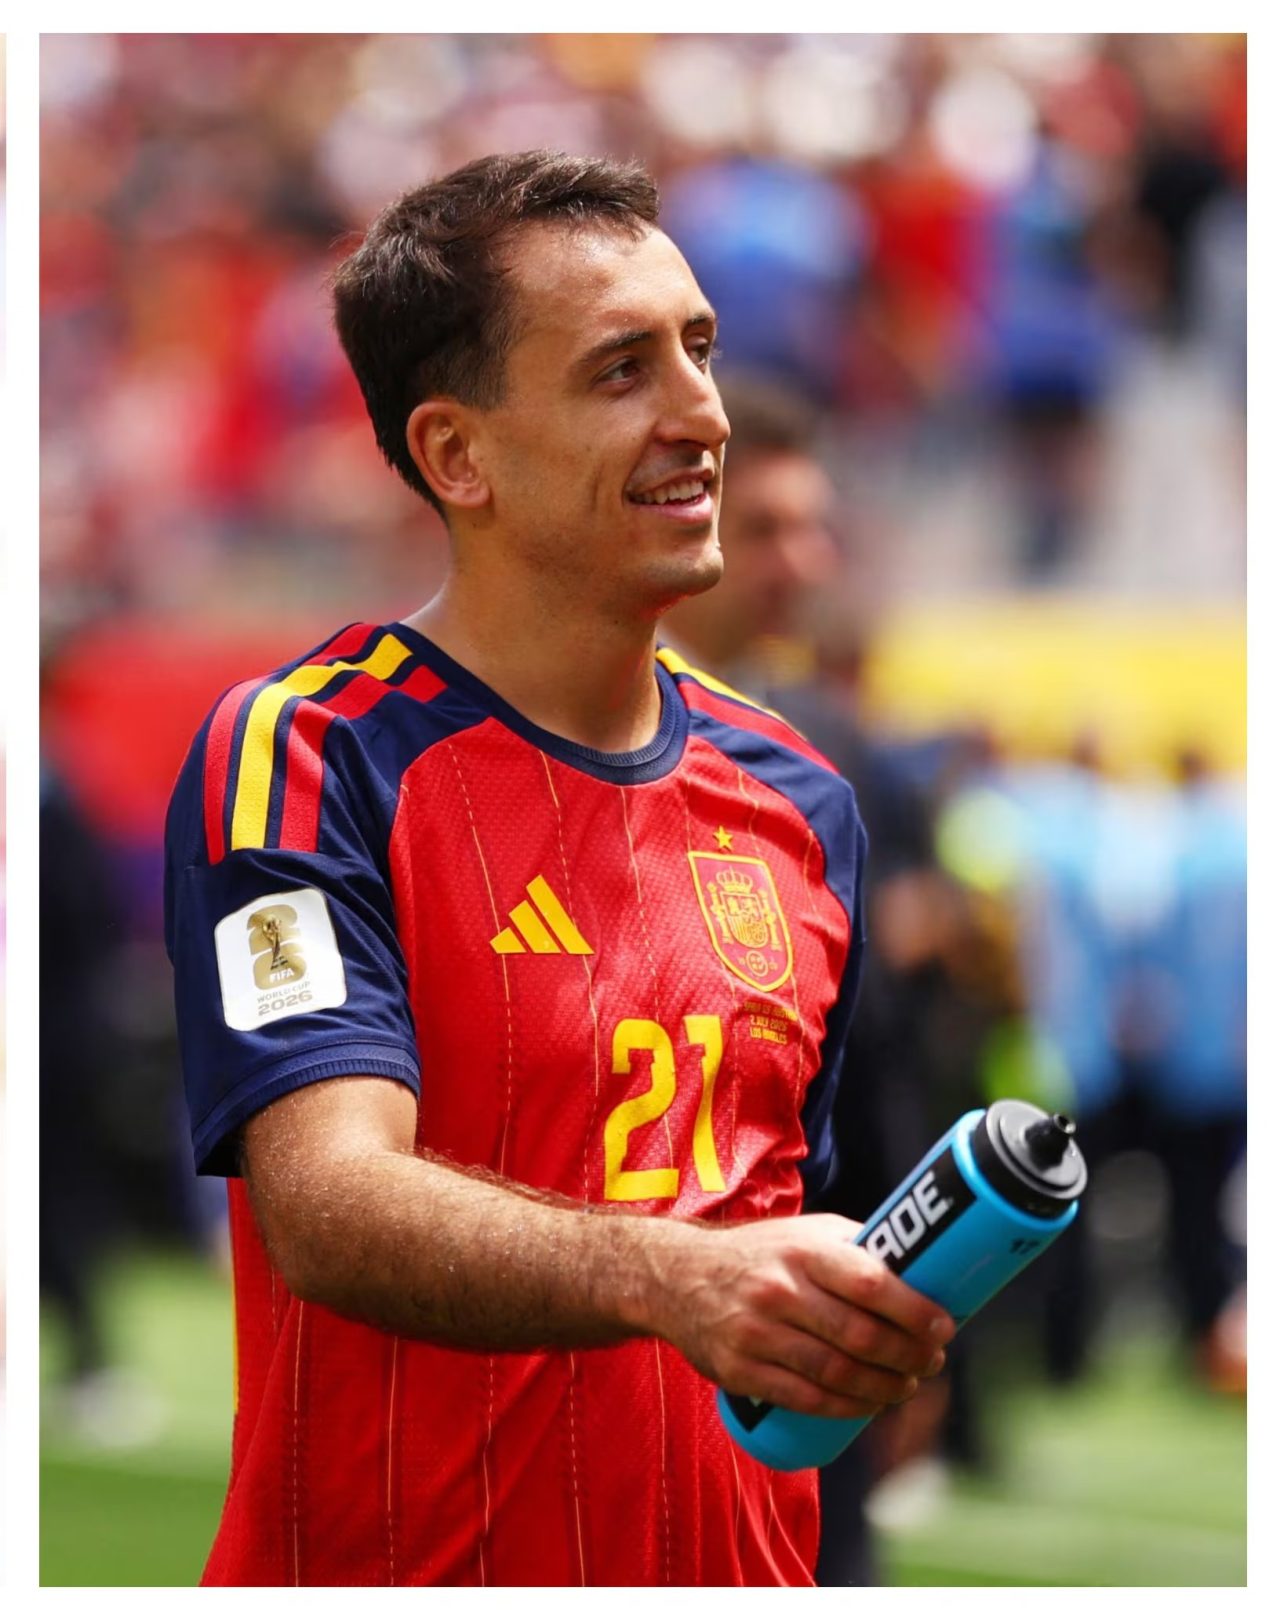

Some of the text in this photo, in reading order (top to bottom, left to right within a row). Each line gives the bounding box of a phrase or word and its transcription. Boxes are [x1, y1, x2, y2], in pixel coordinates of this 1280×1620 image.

[269, 967, 295, 983] FIFA
[256, 980, 311, 1004] WORLD CUP
[258, 990, 313, 1016] 2026
[604, 1015, 726, 1200] 21
[866, 1169, 951, 1260] ADE
